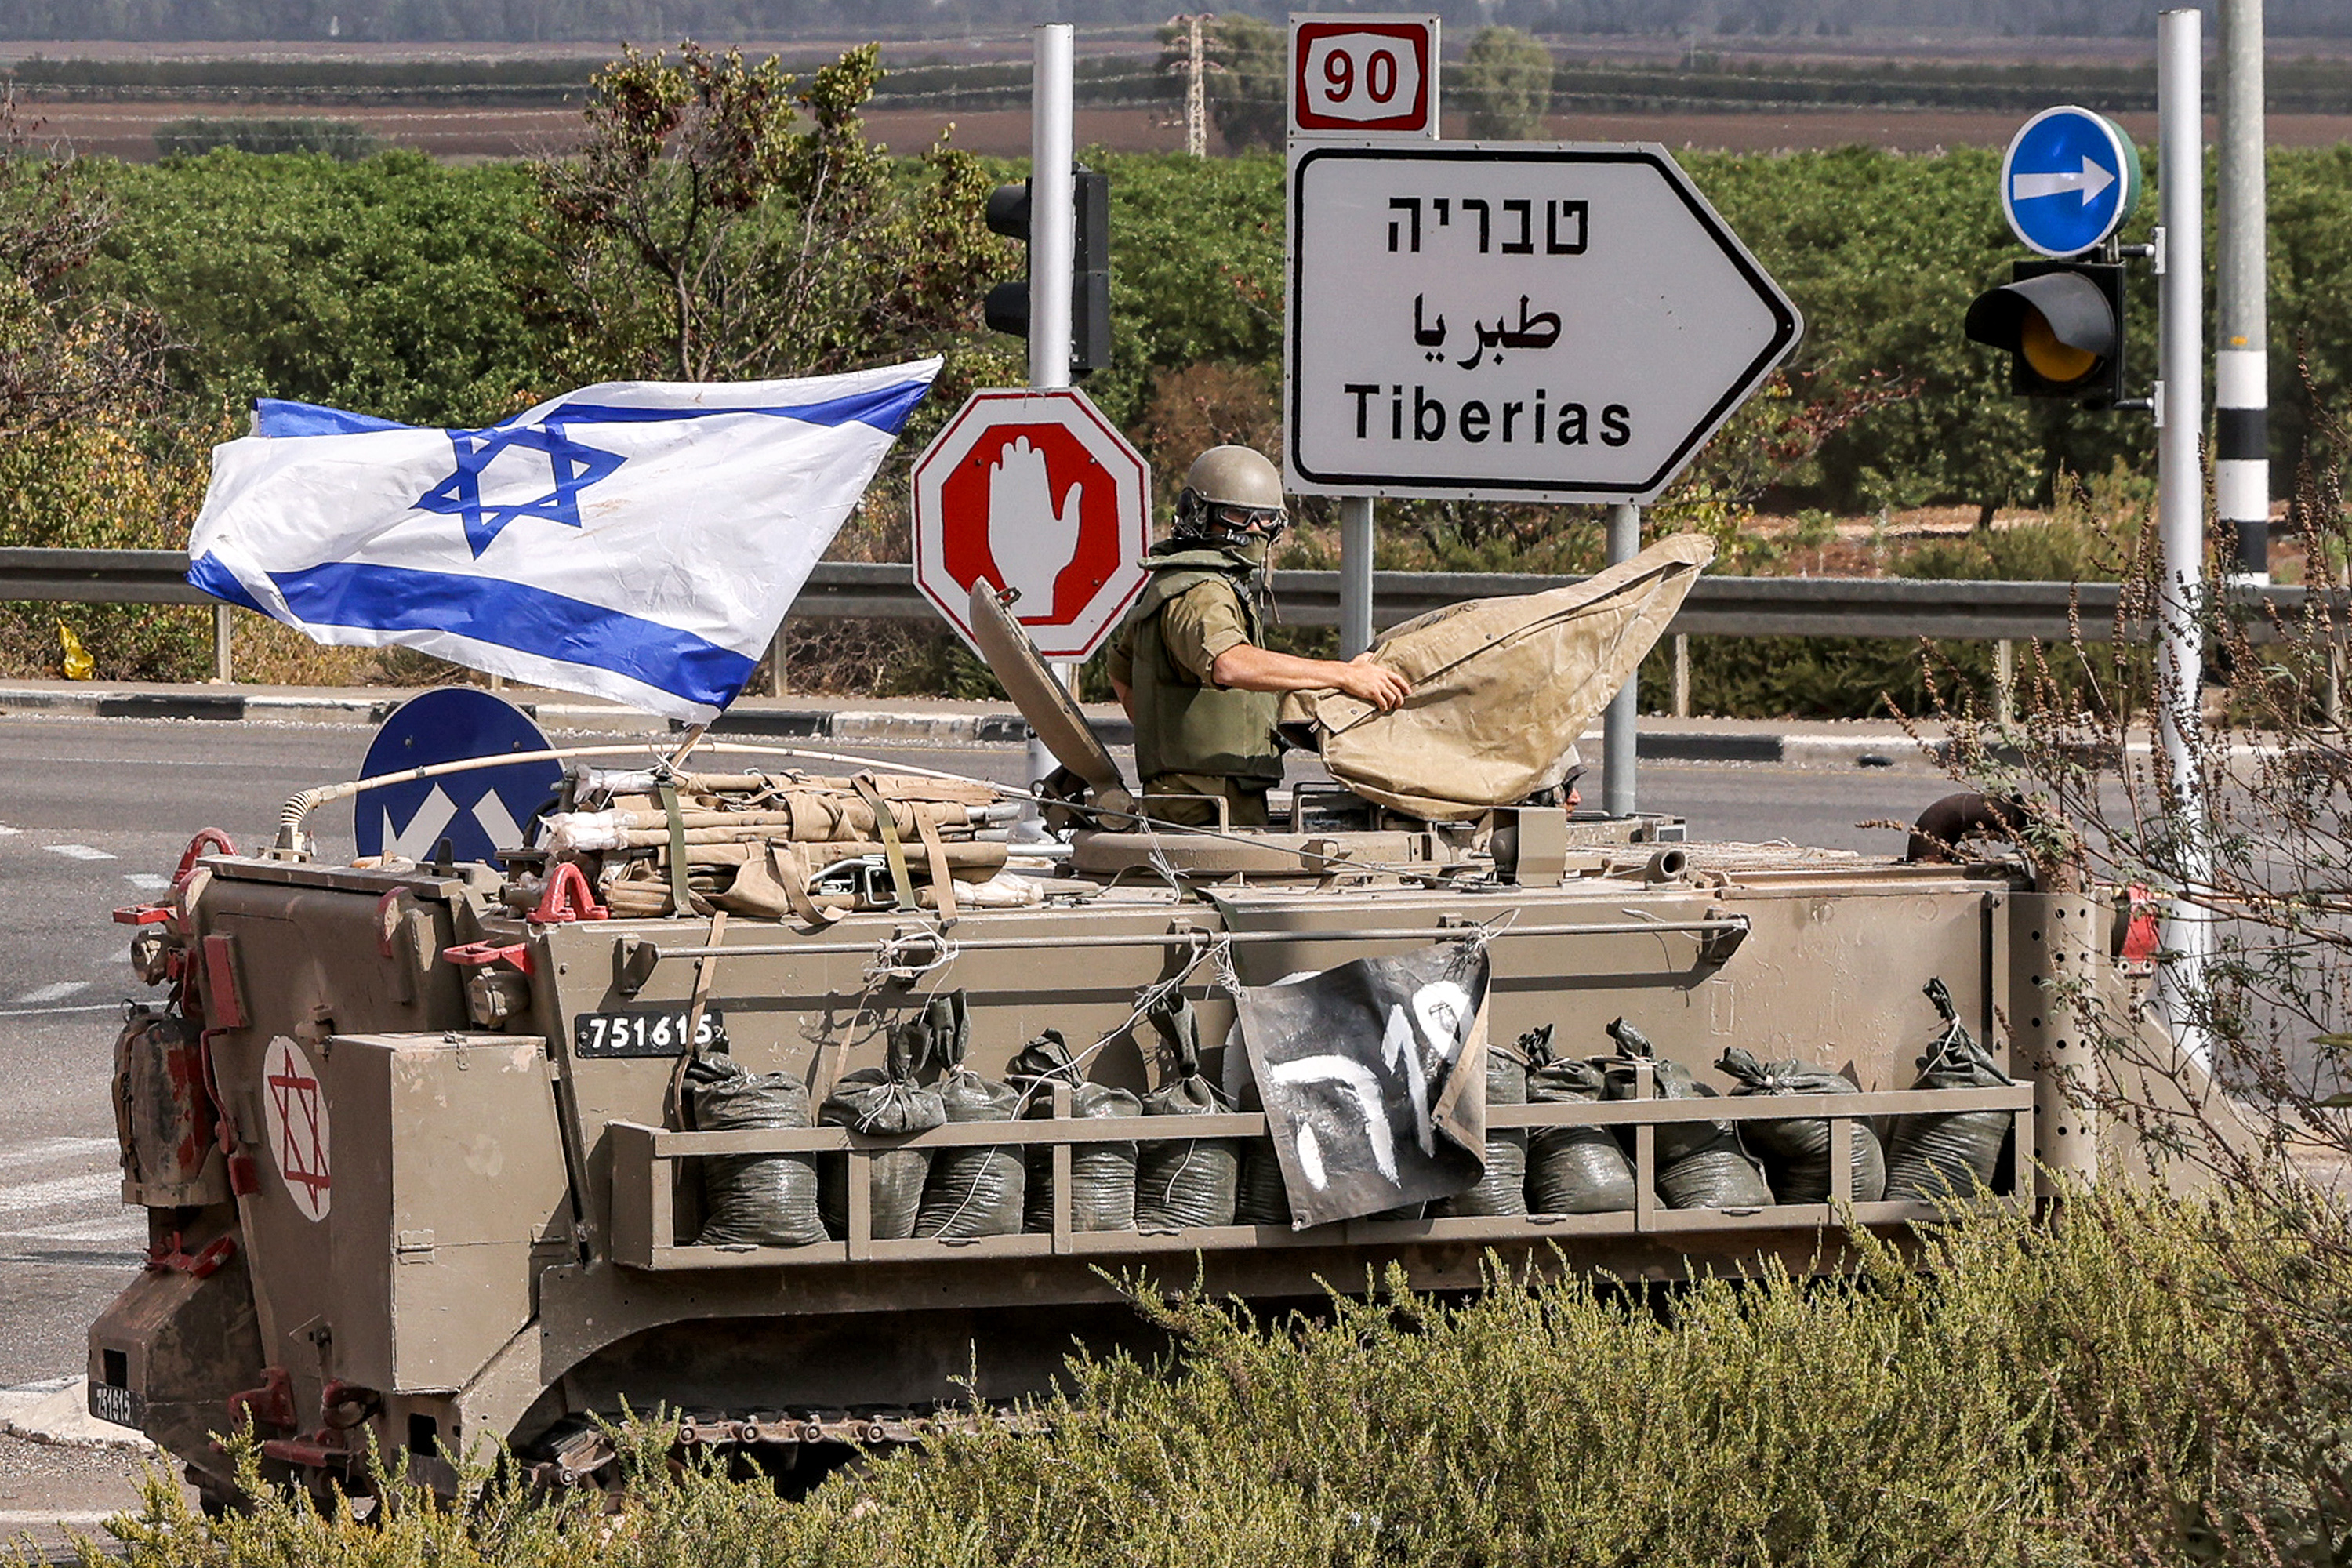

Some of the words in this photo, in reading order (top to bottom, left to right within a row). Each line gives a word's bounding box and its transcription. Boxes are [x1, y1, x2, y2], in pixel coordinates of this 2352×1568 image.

[1323, 49, 1397, 103] 90
[1388, 197, 1588, 254] טבריה
[1414, 292, 1562, 369] طبريا
[1344, 383, 1631, 446] Tiberias
[590, 1014, 712, 1048] 751615
